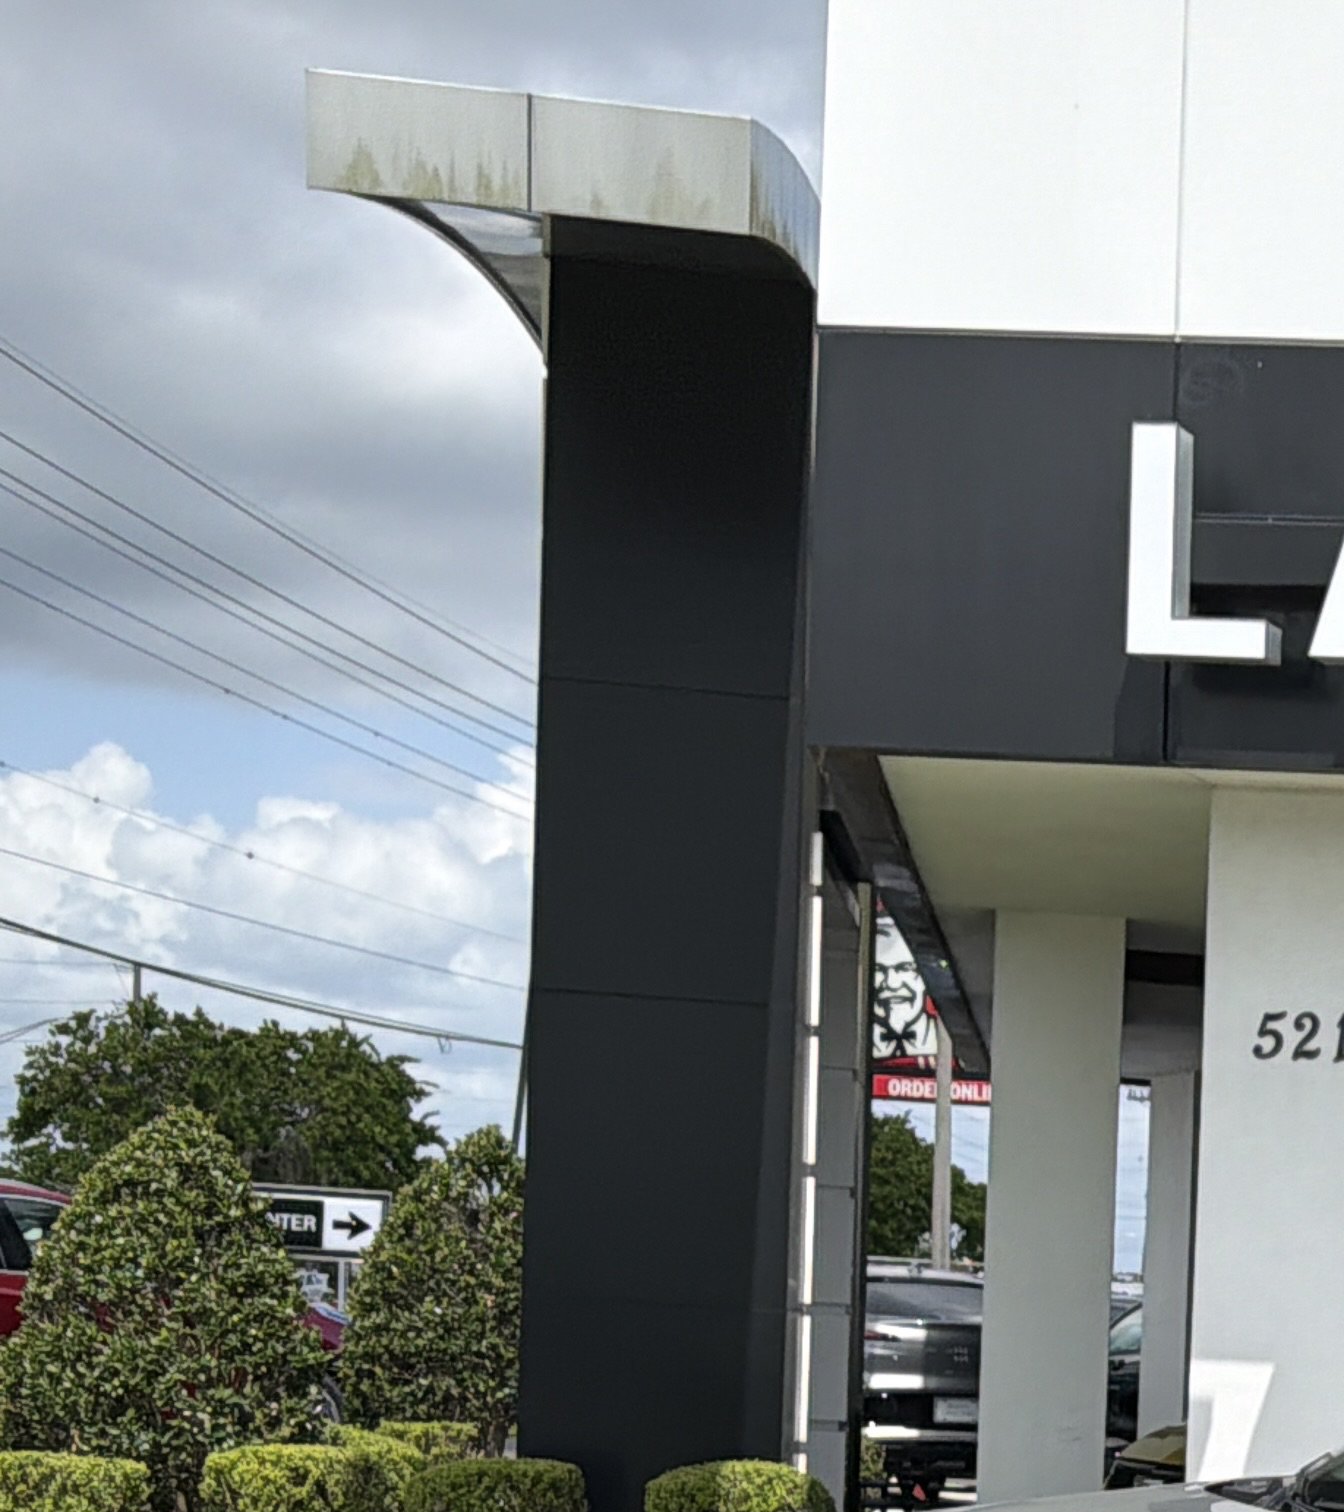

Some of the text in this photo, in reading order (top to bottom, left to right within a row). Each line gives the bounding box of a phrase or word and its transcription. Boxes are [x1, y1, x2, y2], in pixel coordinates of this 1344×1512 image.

[887, 1078, 992, 1102] ORDE ONLI
[264, 1211, 317, 1233] NTER
